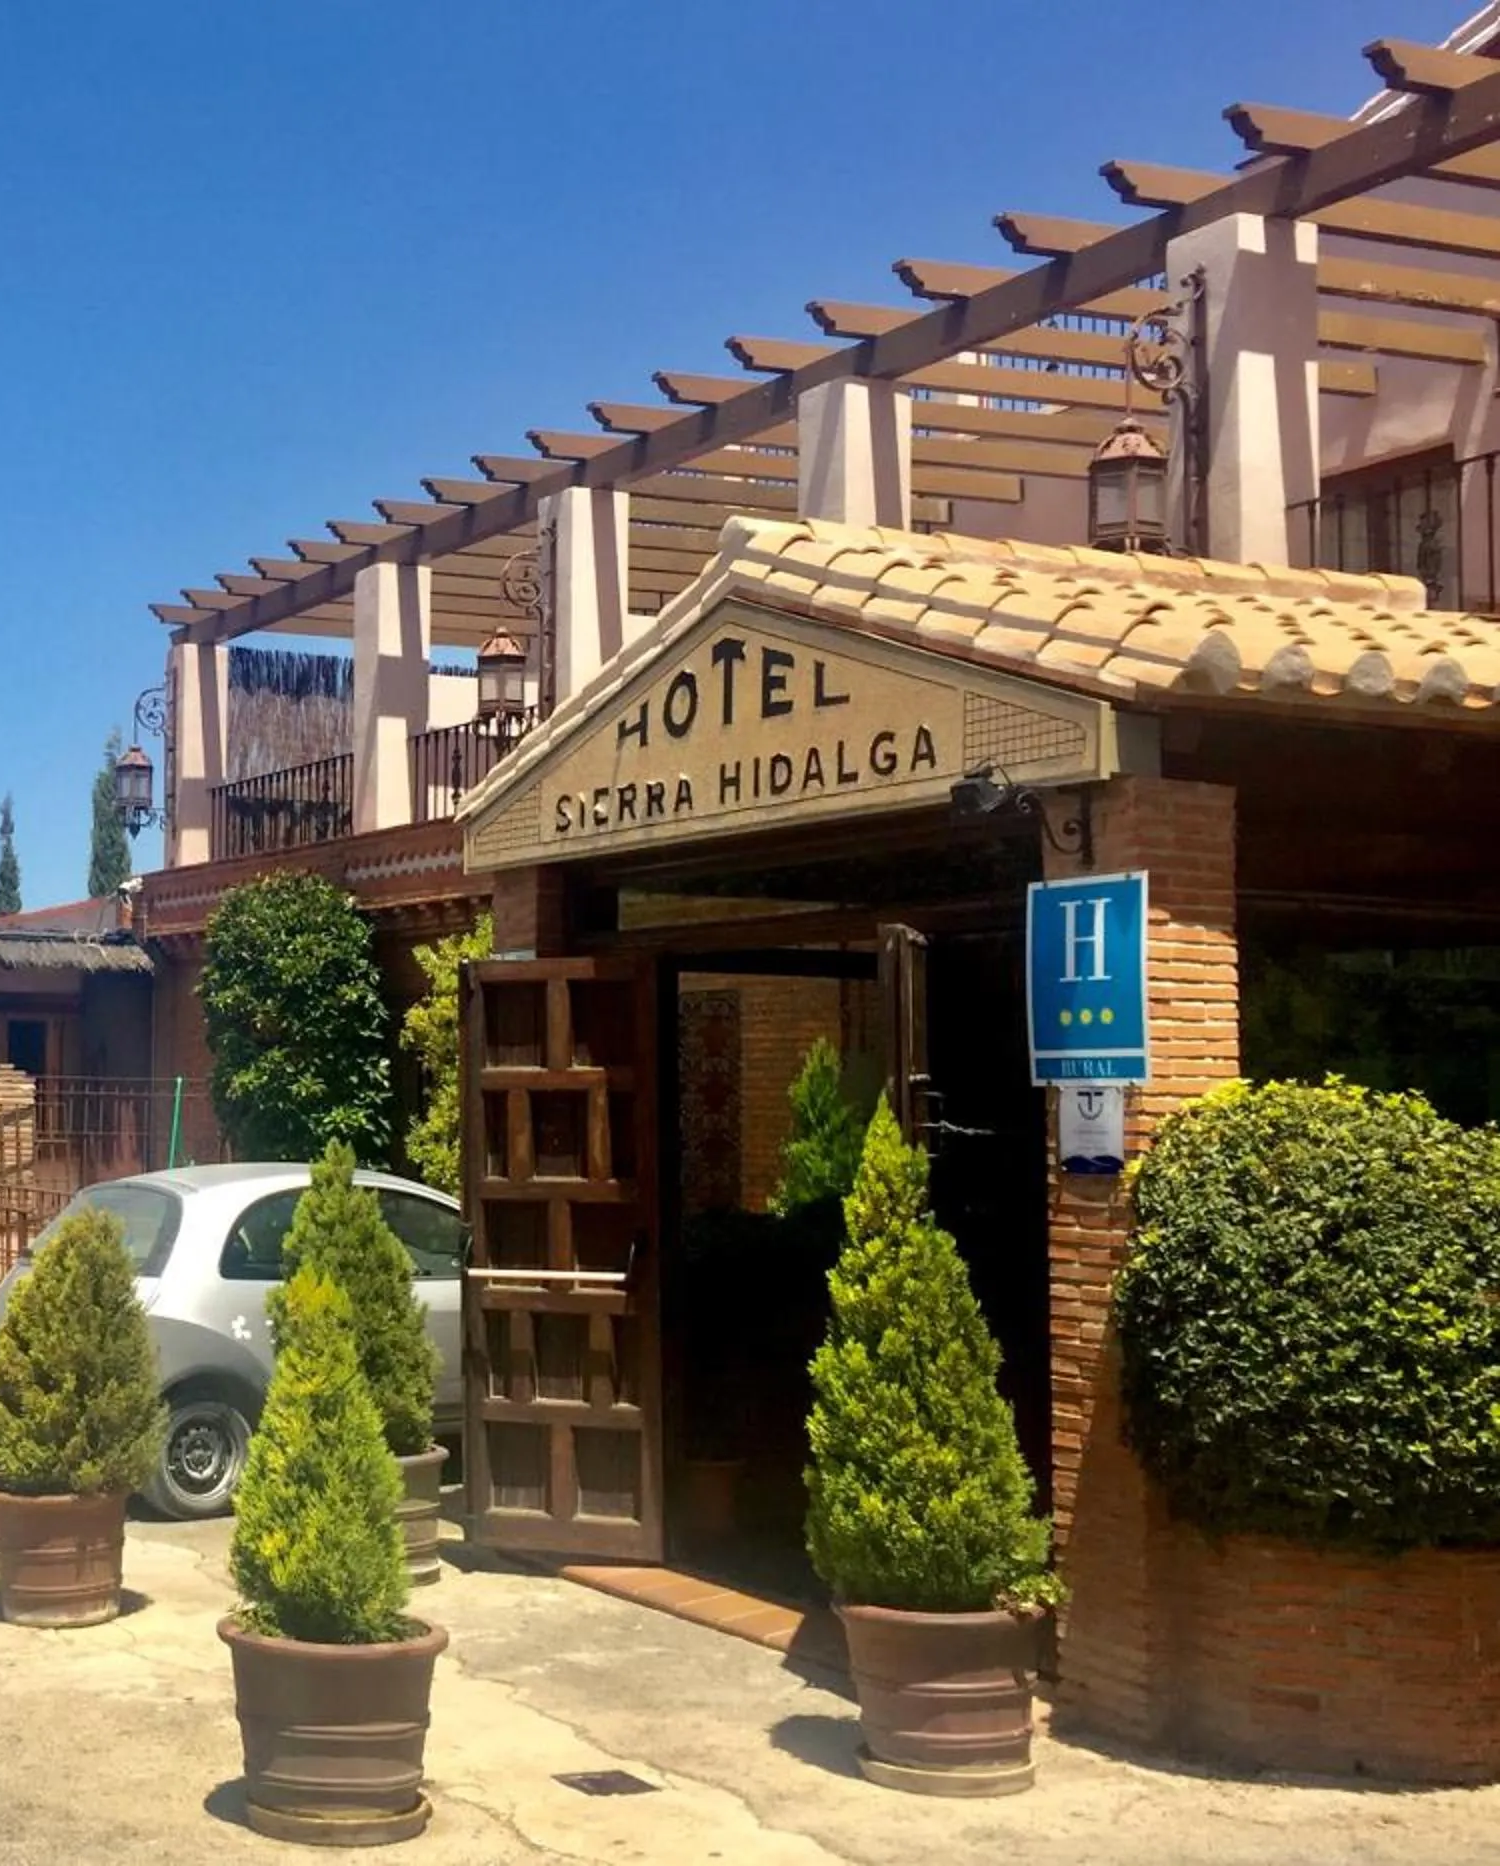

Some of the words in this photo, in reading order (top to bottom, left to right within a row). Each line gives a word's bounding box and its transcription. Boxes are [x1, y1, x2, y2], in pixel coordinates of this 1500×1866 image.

[617, 637, 850, 749] HOTEL
[555, 774, 694, 833] SIERRA
[719, 724, 937, 804] HIDALGA
[1059, 897, 1112, 982] H
[1061, 1058, 1116, 1078] RURAL
